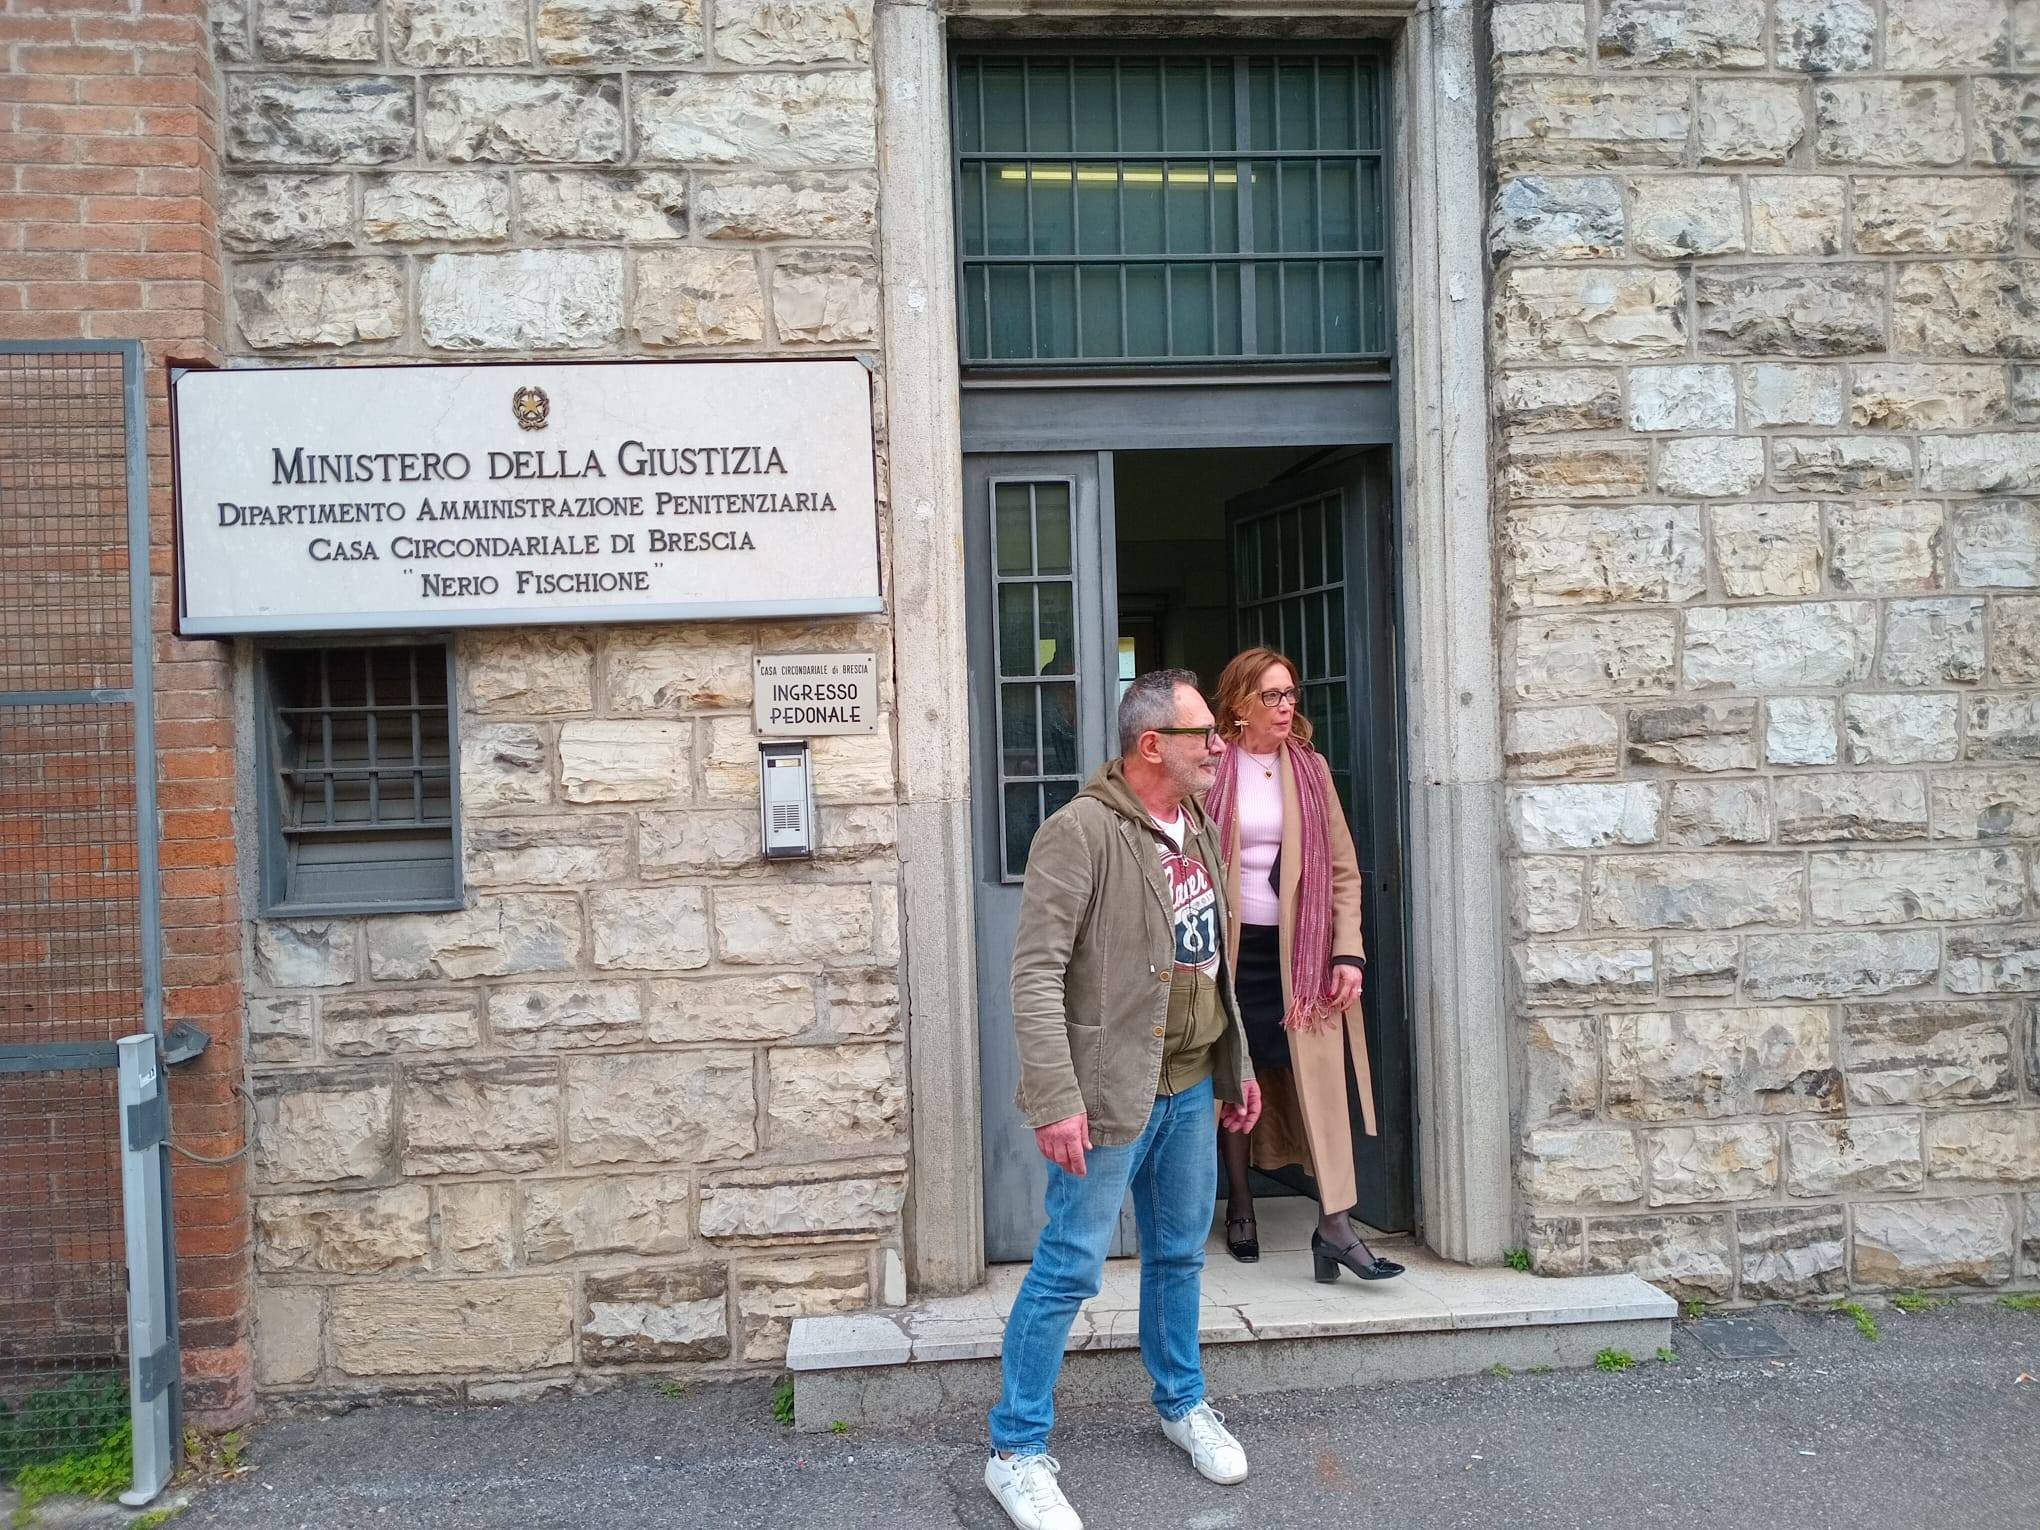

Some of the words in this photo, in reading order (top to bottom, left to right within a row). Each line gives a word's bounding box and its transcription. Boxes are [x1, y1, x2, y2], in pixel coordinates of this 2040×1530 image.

[271, 446, 471, 486] MINISTERO
[487, 449, 607, 481] DELLA
[617, 439, 789, 477] GIUSTIZIA
[217, 502, 406, 528] DIPARTIMENTO
[415, 496, 645, 522] AMMINISTRAZIONE
[655, 491, 837, 516] PENITENZIARIA
[308, 537, 380, 562] CASA
[390, 534, 600, 560] CIRCONDARIALE
[610, 533, 636, 554] DI
[647, 528, 756, 553] BRESCIA
[760, 665, 778, 676] CASA
[781, 664, 828, 676] CIRCONDARIALE
[842, 664, 869, 675] BRESCIA
[773, 683, 858, 702] INGRESSO
[769, 705, 861, 725] PEDONALE
